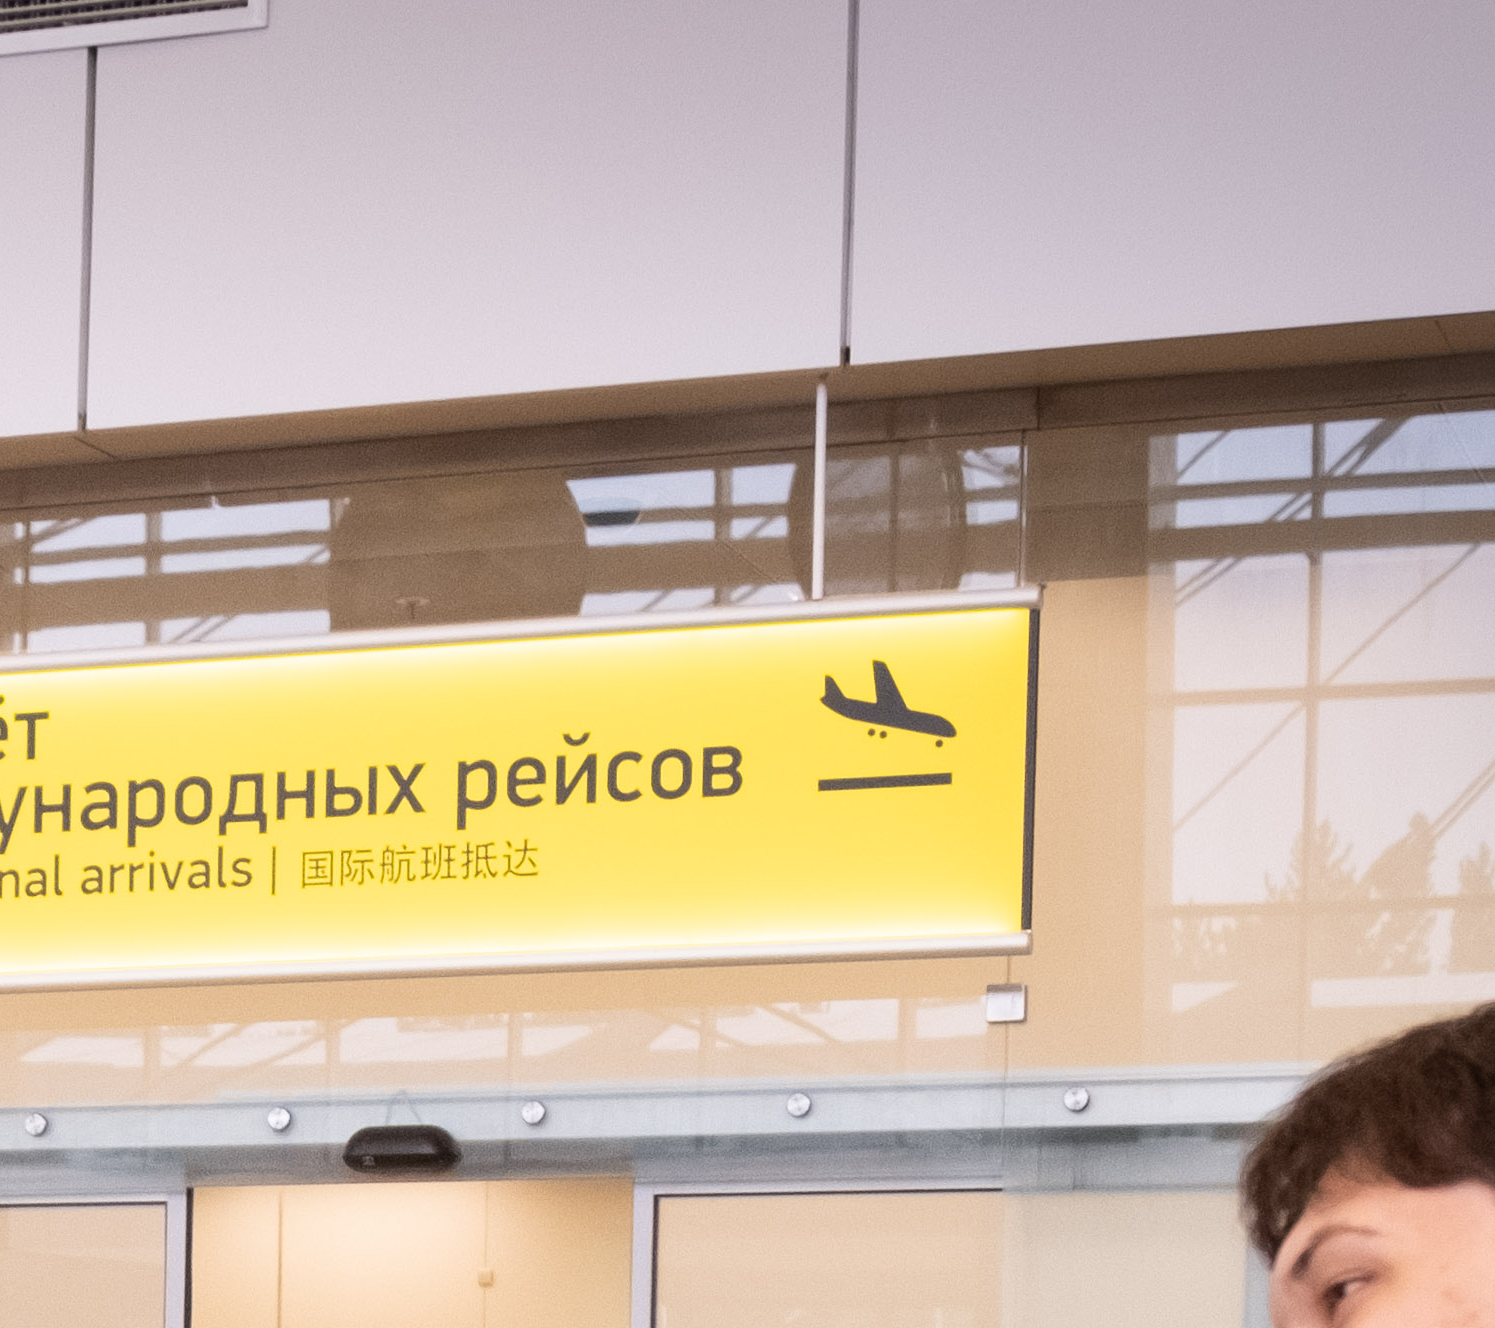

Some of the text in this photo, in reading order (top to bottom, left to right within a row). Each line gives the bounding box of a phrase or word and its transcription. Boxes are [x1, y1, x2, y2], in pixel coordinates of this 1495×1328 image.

[456, 731, 743, 831] рейсов
[80, 845, 252, 895] arrivals
[301, 838, 539, 889] 国际航班抵达
